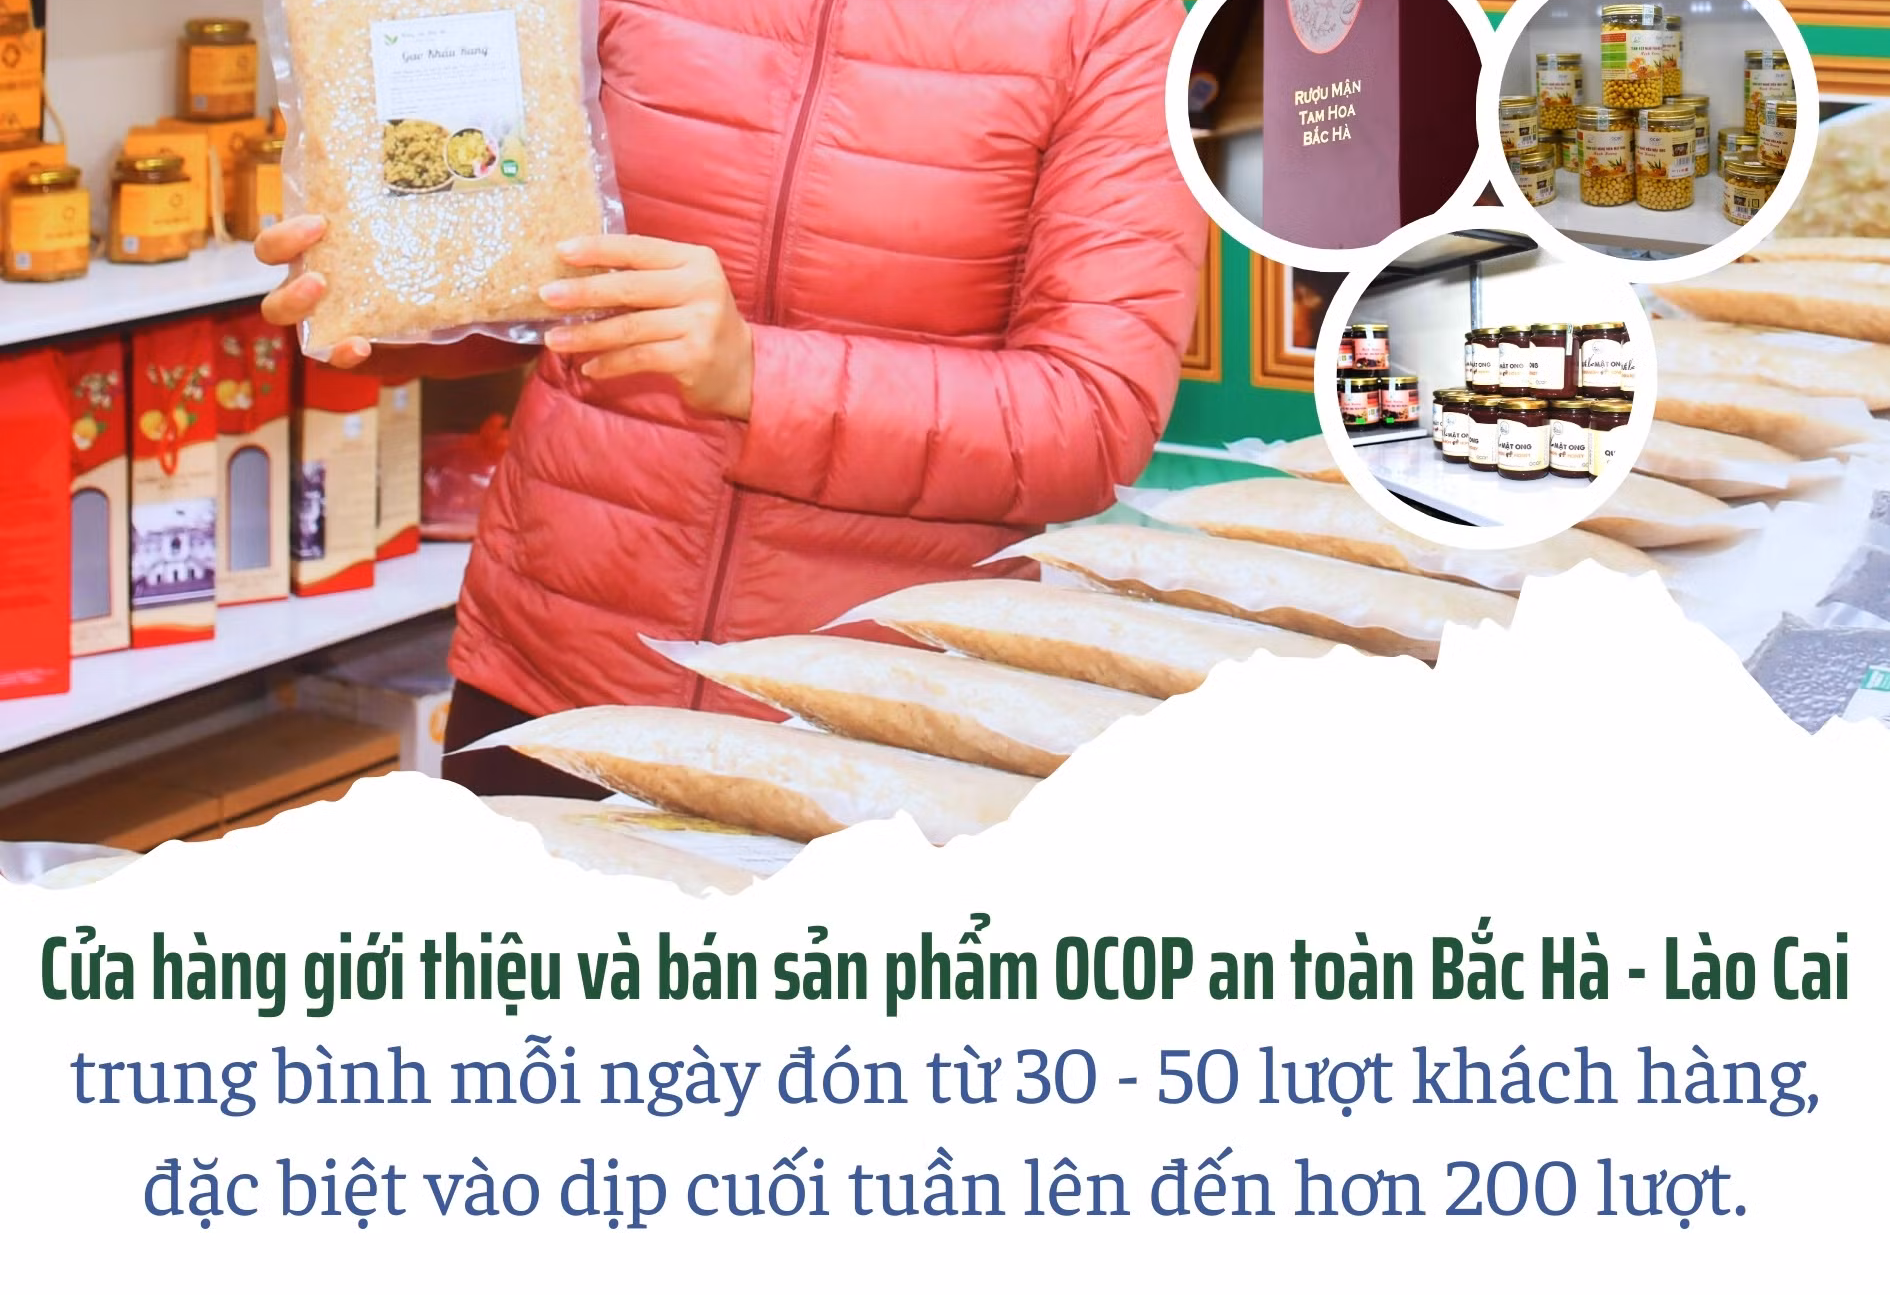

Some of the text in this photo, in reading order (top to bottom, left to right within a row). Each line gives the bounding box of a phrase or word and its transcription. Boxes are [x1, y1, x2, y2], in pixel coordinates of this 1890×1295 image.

[1332, 78, 1361, 98] MẬN
[1303, 123, 1352, 146] BẮC HÀ
[1501, 443, 1514, 451] MẬT
[1554, 442, 1567, 450] MẬT
